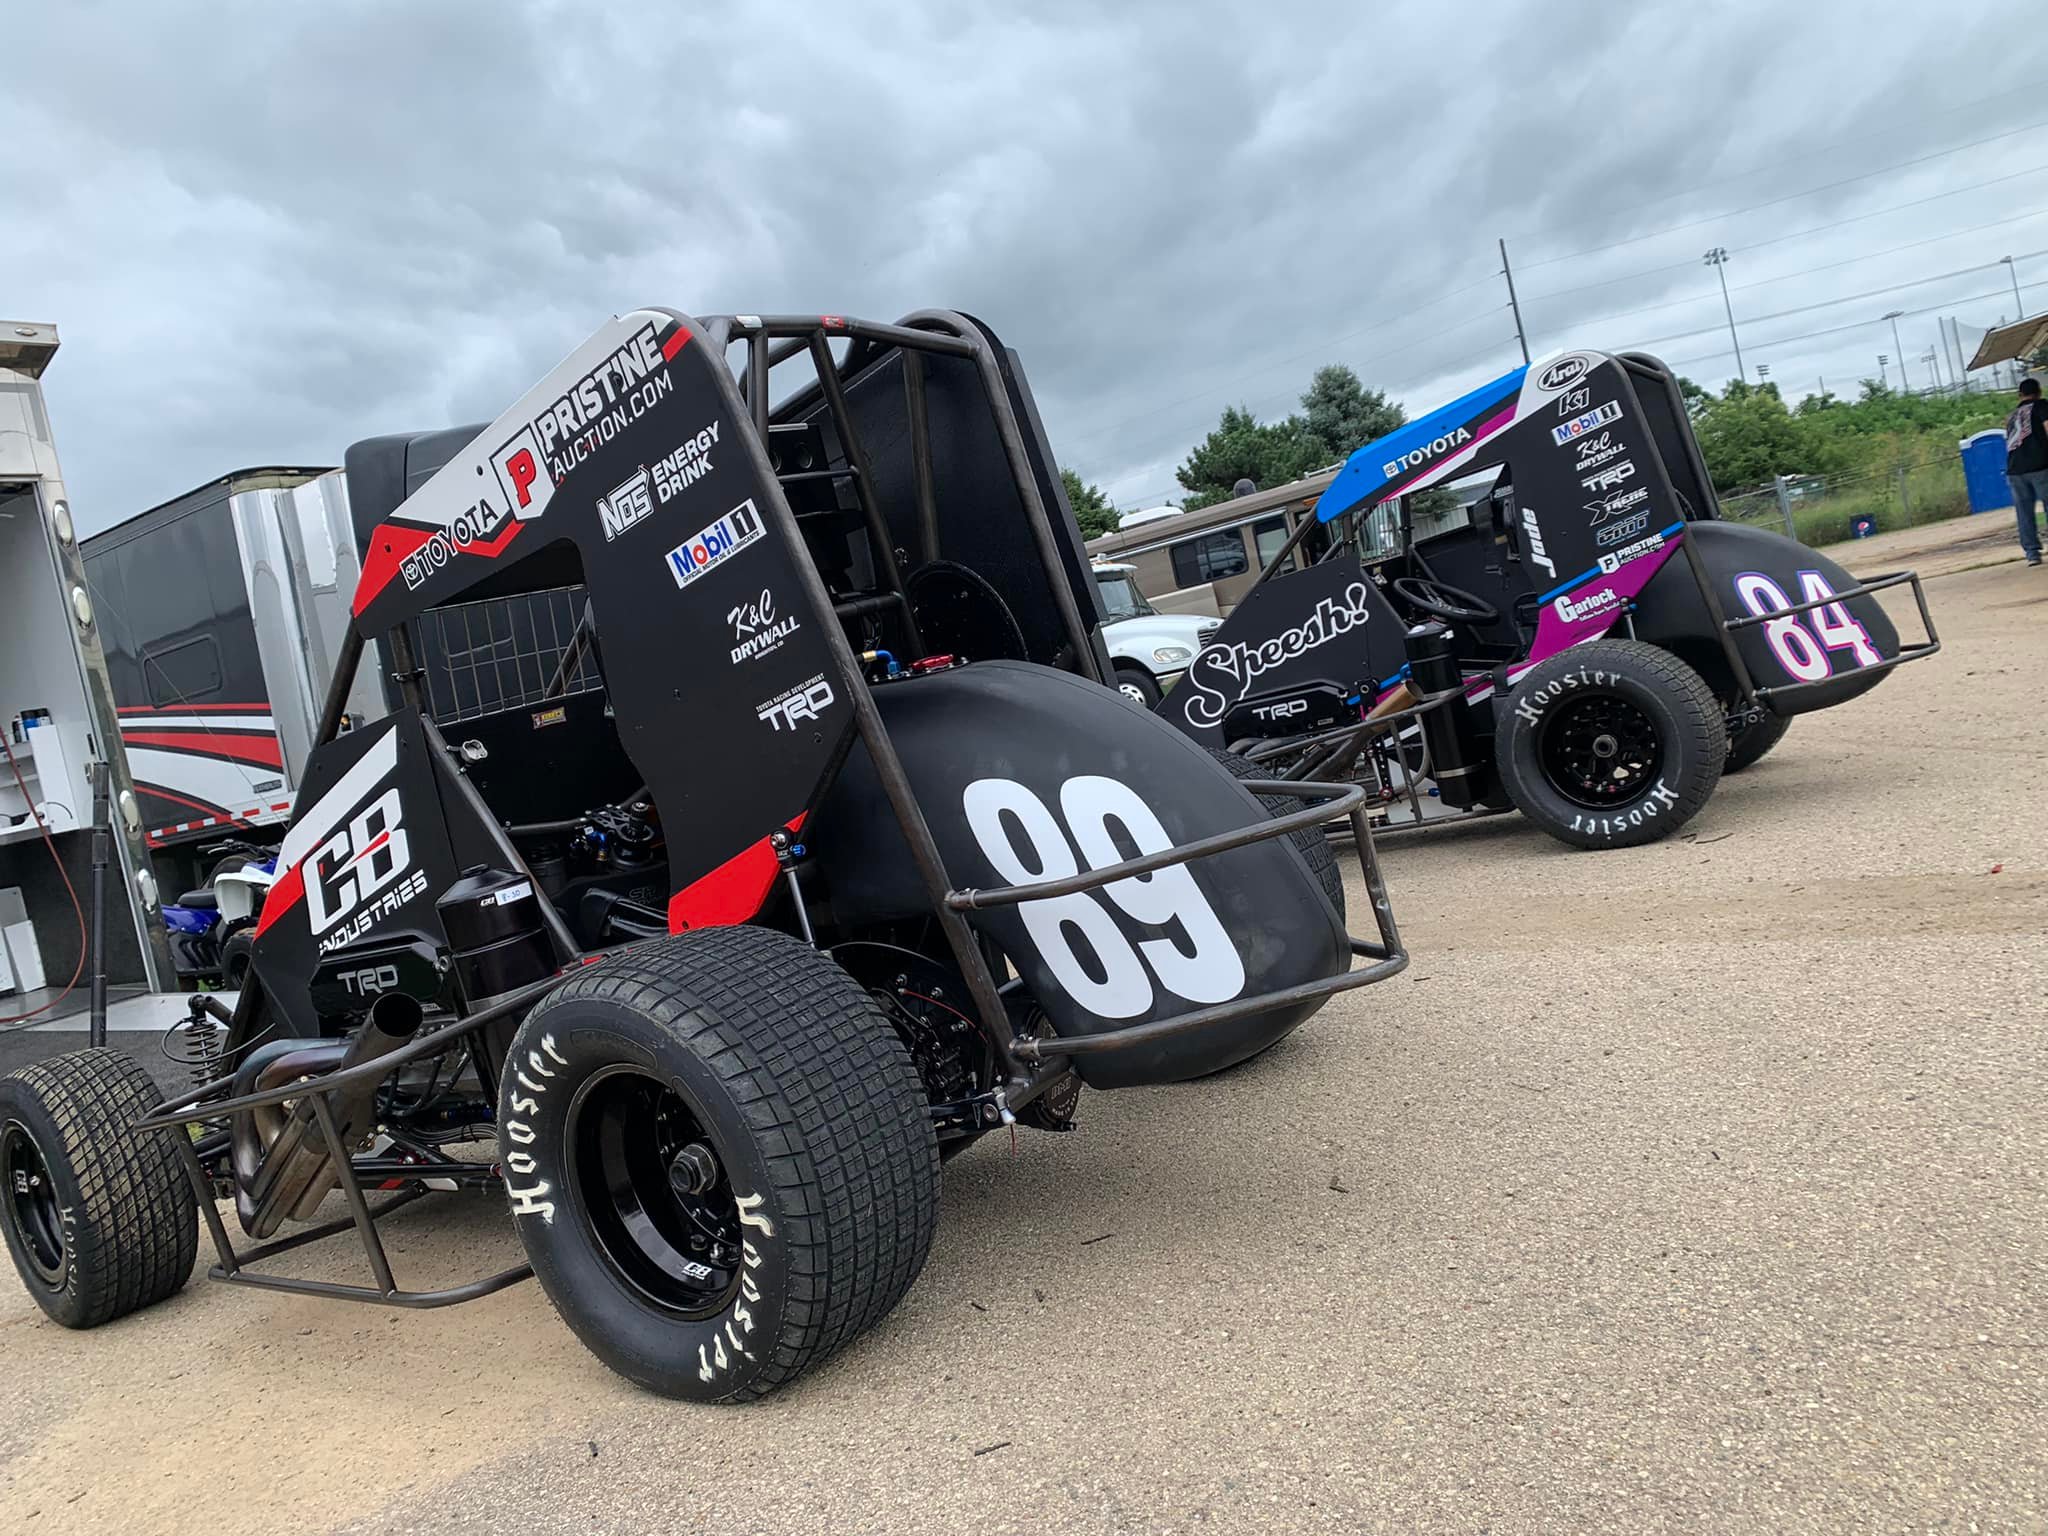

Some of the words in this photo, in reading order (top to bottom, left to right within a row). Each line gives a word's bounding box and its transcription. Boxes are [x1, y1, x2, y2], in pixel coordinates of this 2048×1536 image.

[537, 325, 663, 453] PRISTINE
[1543, 359, 1582, 387] Arai
[555, 369, 673, 480] AUCTION.COM
[1557, 411, 1599, 440] Mobil
[1559, 387, 1590, 417] K1
[651, 420, 719, 485] ENERGY
[1397, 427, 1472, 470] TOYOTA
[1576, 443, 1627, 471] DRYWALL
[1577, 431, 1611, 459] K&C
[656, 452, 714, 504] DRINK
[1582, 463, 1636, 491] TRD
[596, 463, 654, 543] NOS
[416, 498, 498, 576] TOYOTA
[671, 521, 733, 577] Mobil
[735, 511, 750, 534] 1
[1616, 532, 1664, 559] PRISTINE
[727, 589, 775, 640] K&C
[1554, 588, 1617, 623] Garlock
[1733, 569, 1884, 683] 84
[730, 616, 800, 664] DRYWALL
[1184, 582, 1370, 728] Sheesh!
[758, 681, 834, 731] TRD
[1252, 699, 1308, 720] TRD
[1515, 665, 1621, 727] Hoosier
[1569, 778, 1679, 840] Hoosier
[302, 788, 410, 936] CB
[319, 868, 428, 956] INDUSTRIES
[963, 775, 1245, 1019] 89
[337, 964, 399, 996] TRD
